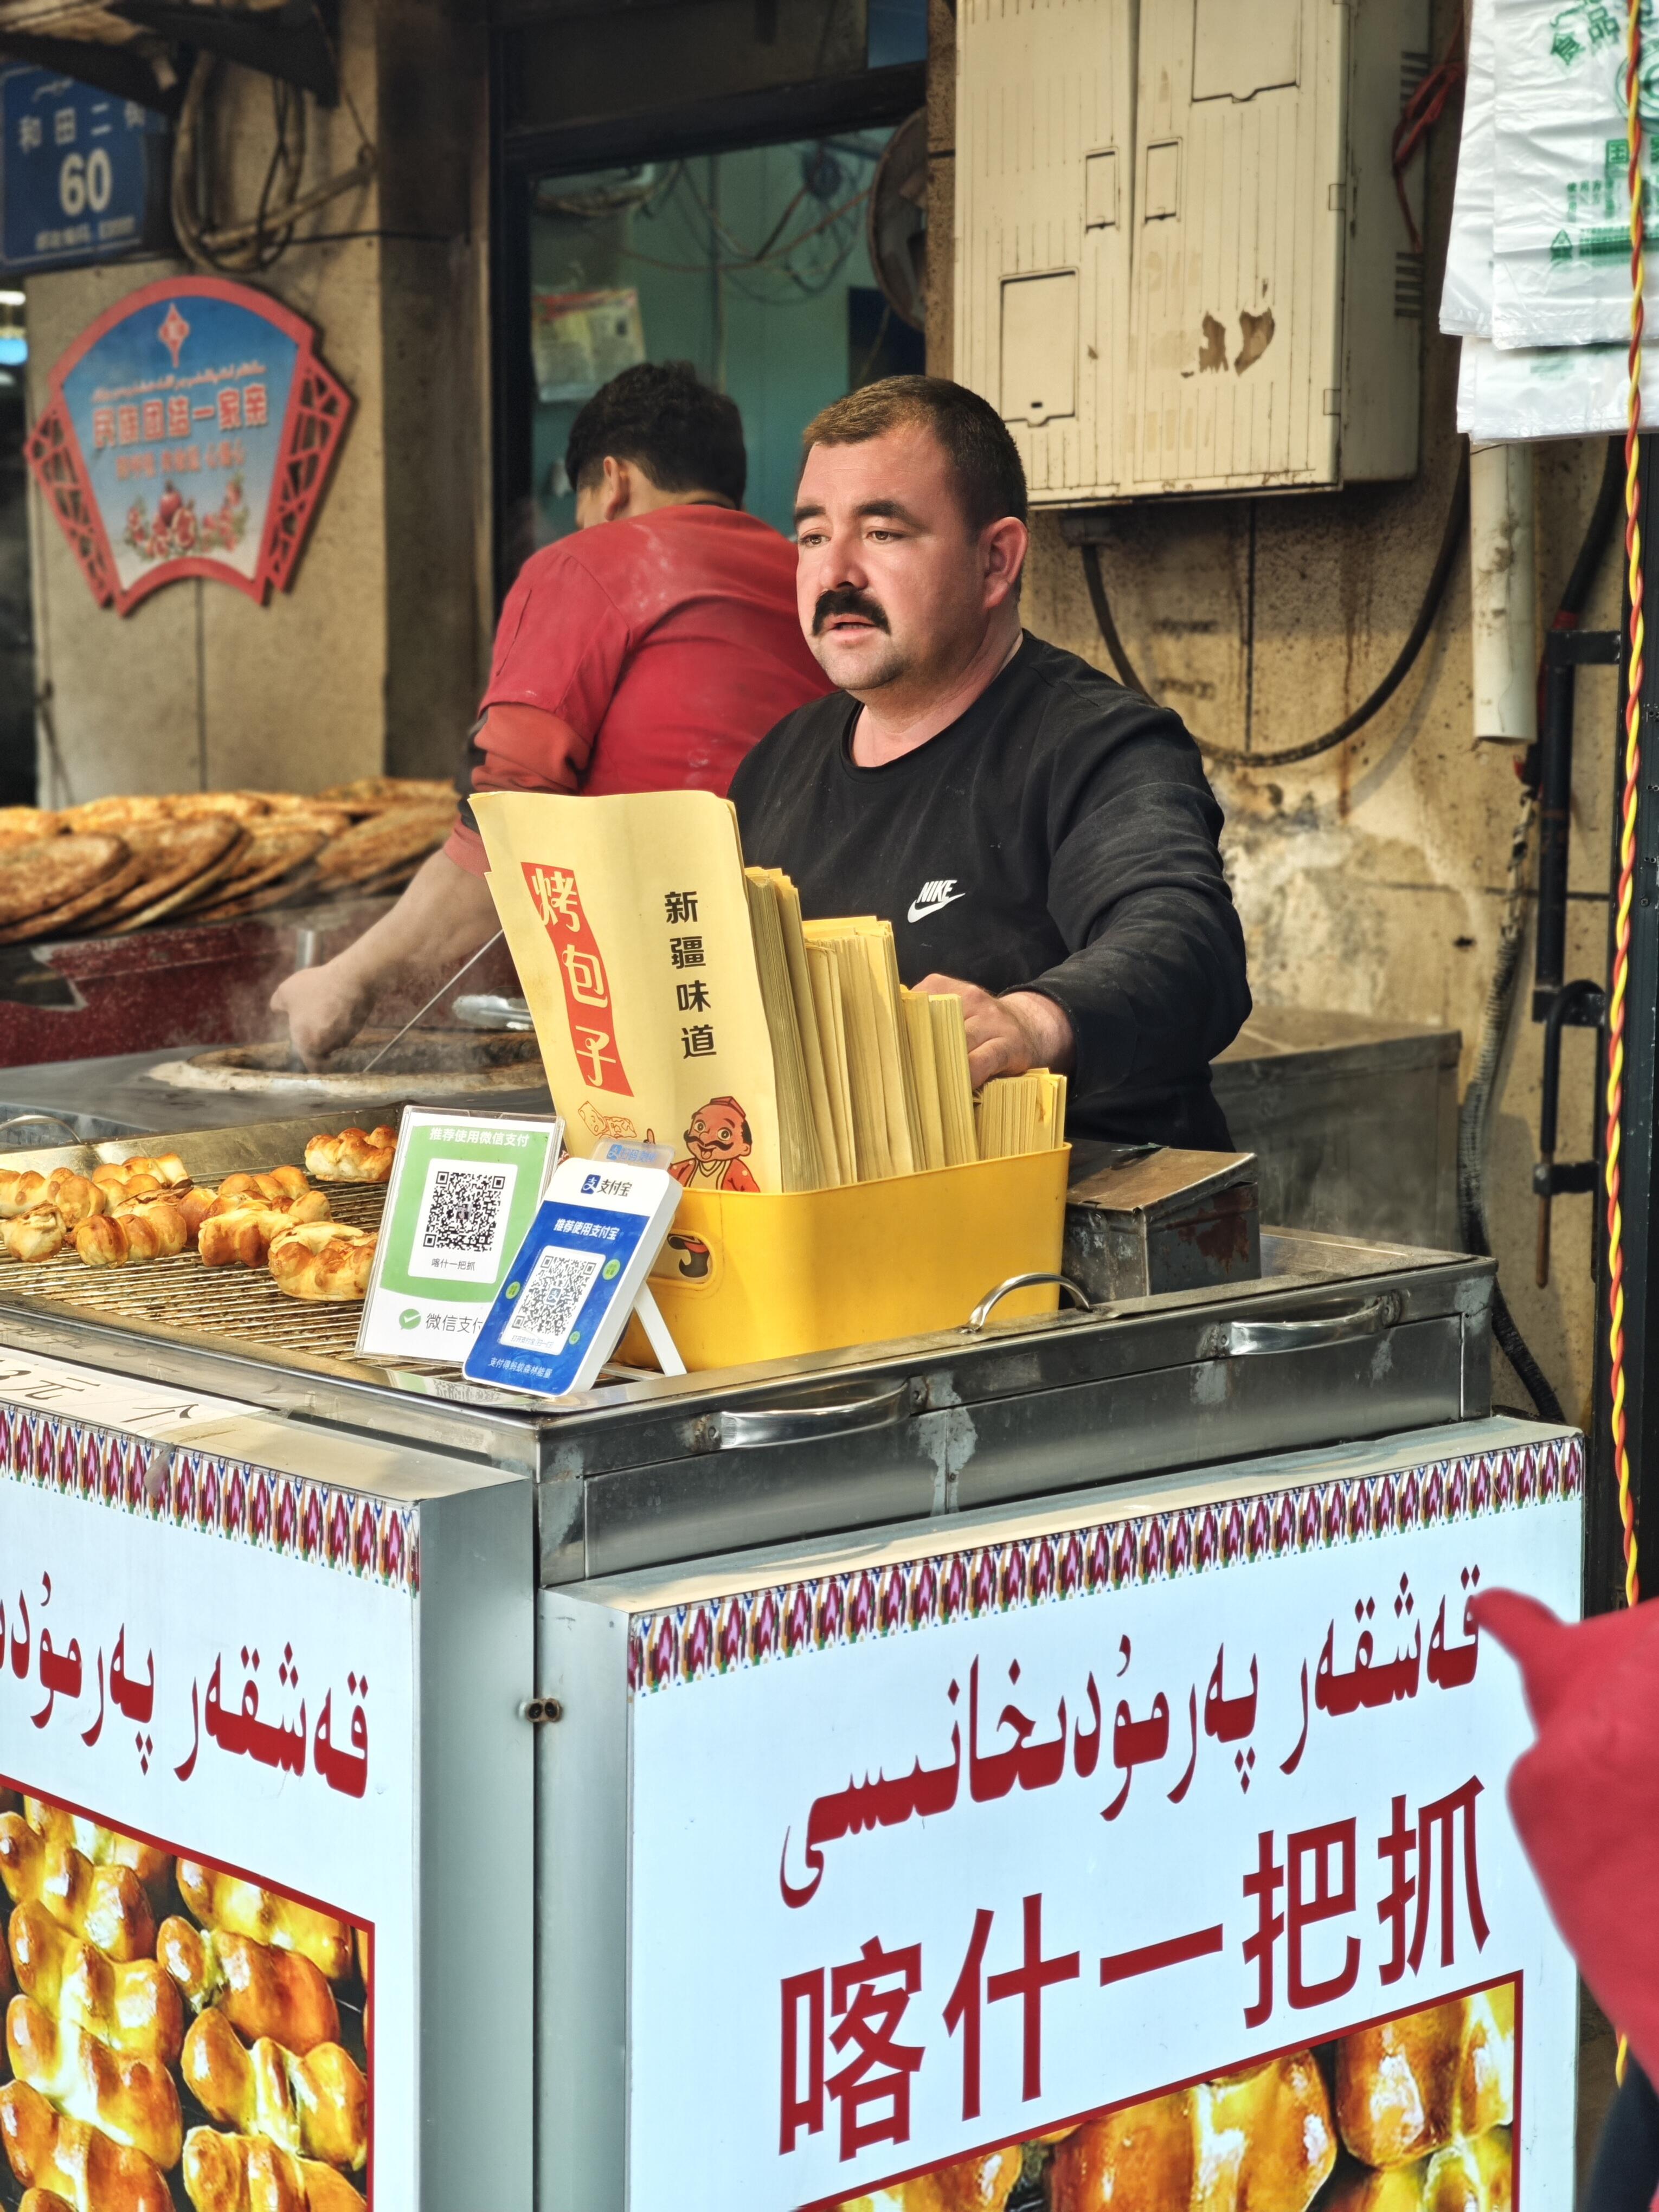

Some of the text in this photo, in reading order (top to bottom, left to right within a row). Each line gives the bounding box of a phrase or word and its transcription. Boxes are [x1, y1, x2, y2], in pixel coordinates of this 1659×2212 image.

[60, 147, 112, 216] 60
[916, 880, 957, 903] NIKE
[531, 867, 616, 1086] 烤包子
[665, 891, 717, 1059] 新疆味道
[429, 1127, 530, 1147] 推荐使用微信支付
[596, 1179, 633, 1197] 支付宝
[553, 1218, 620, 1240] 推荐使用支付宝
[432, 1258, 475, 1271] 喀什一把抓
[779, 1774, 1491, 2162] 喀什一把抓
